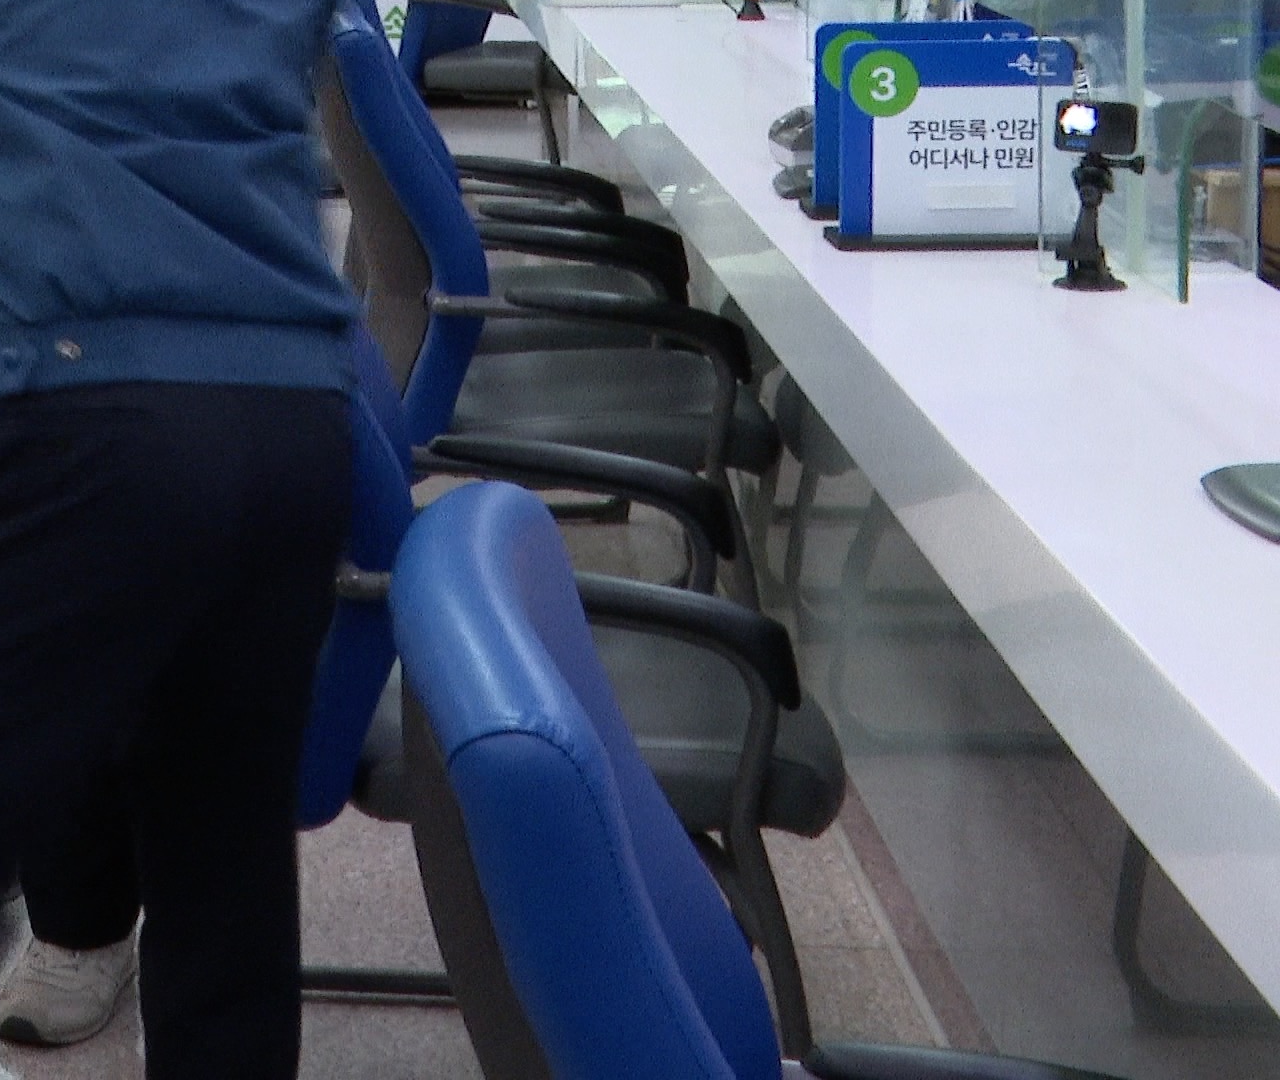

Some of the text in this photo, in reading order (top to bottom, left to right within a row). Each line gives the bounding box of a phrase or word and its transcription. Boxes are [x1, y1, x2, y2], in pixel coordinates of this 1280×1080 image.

[870, 66, 897, 101] 3
[909, 147, 1035, 169] 어디서나 민원
